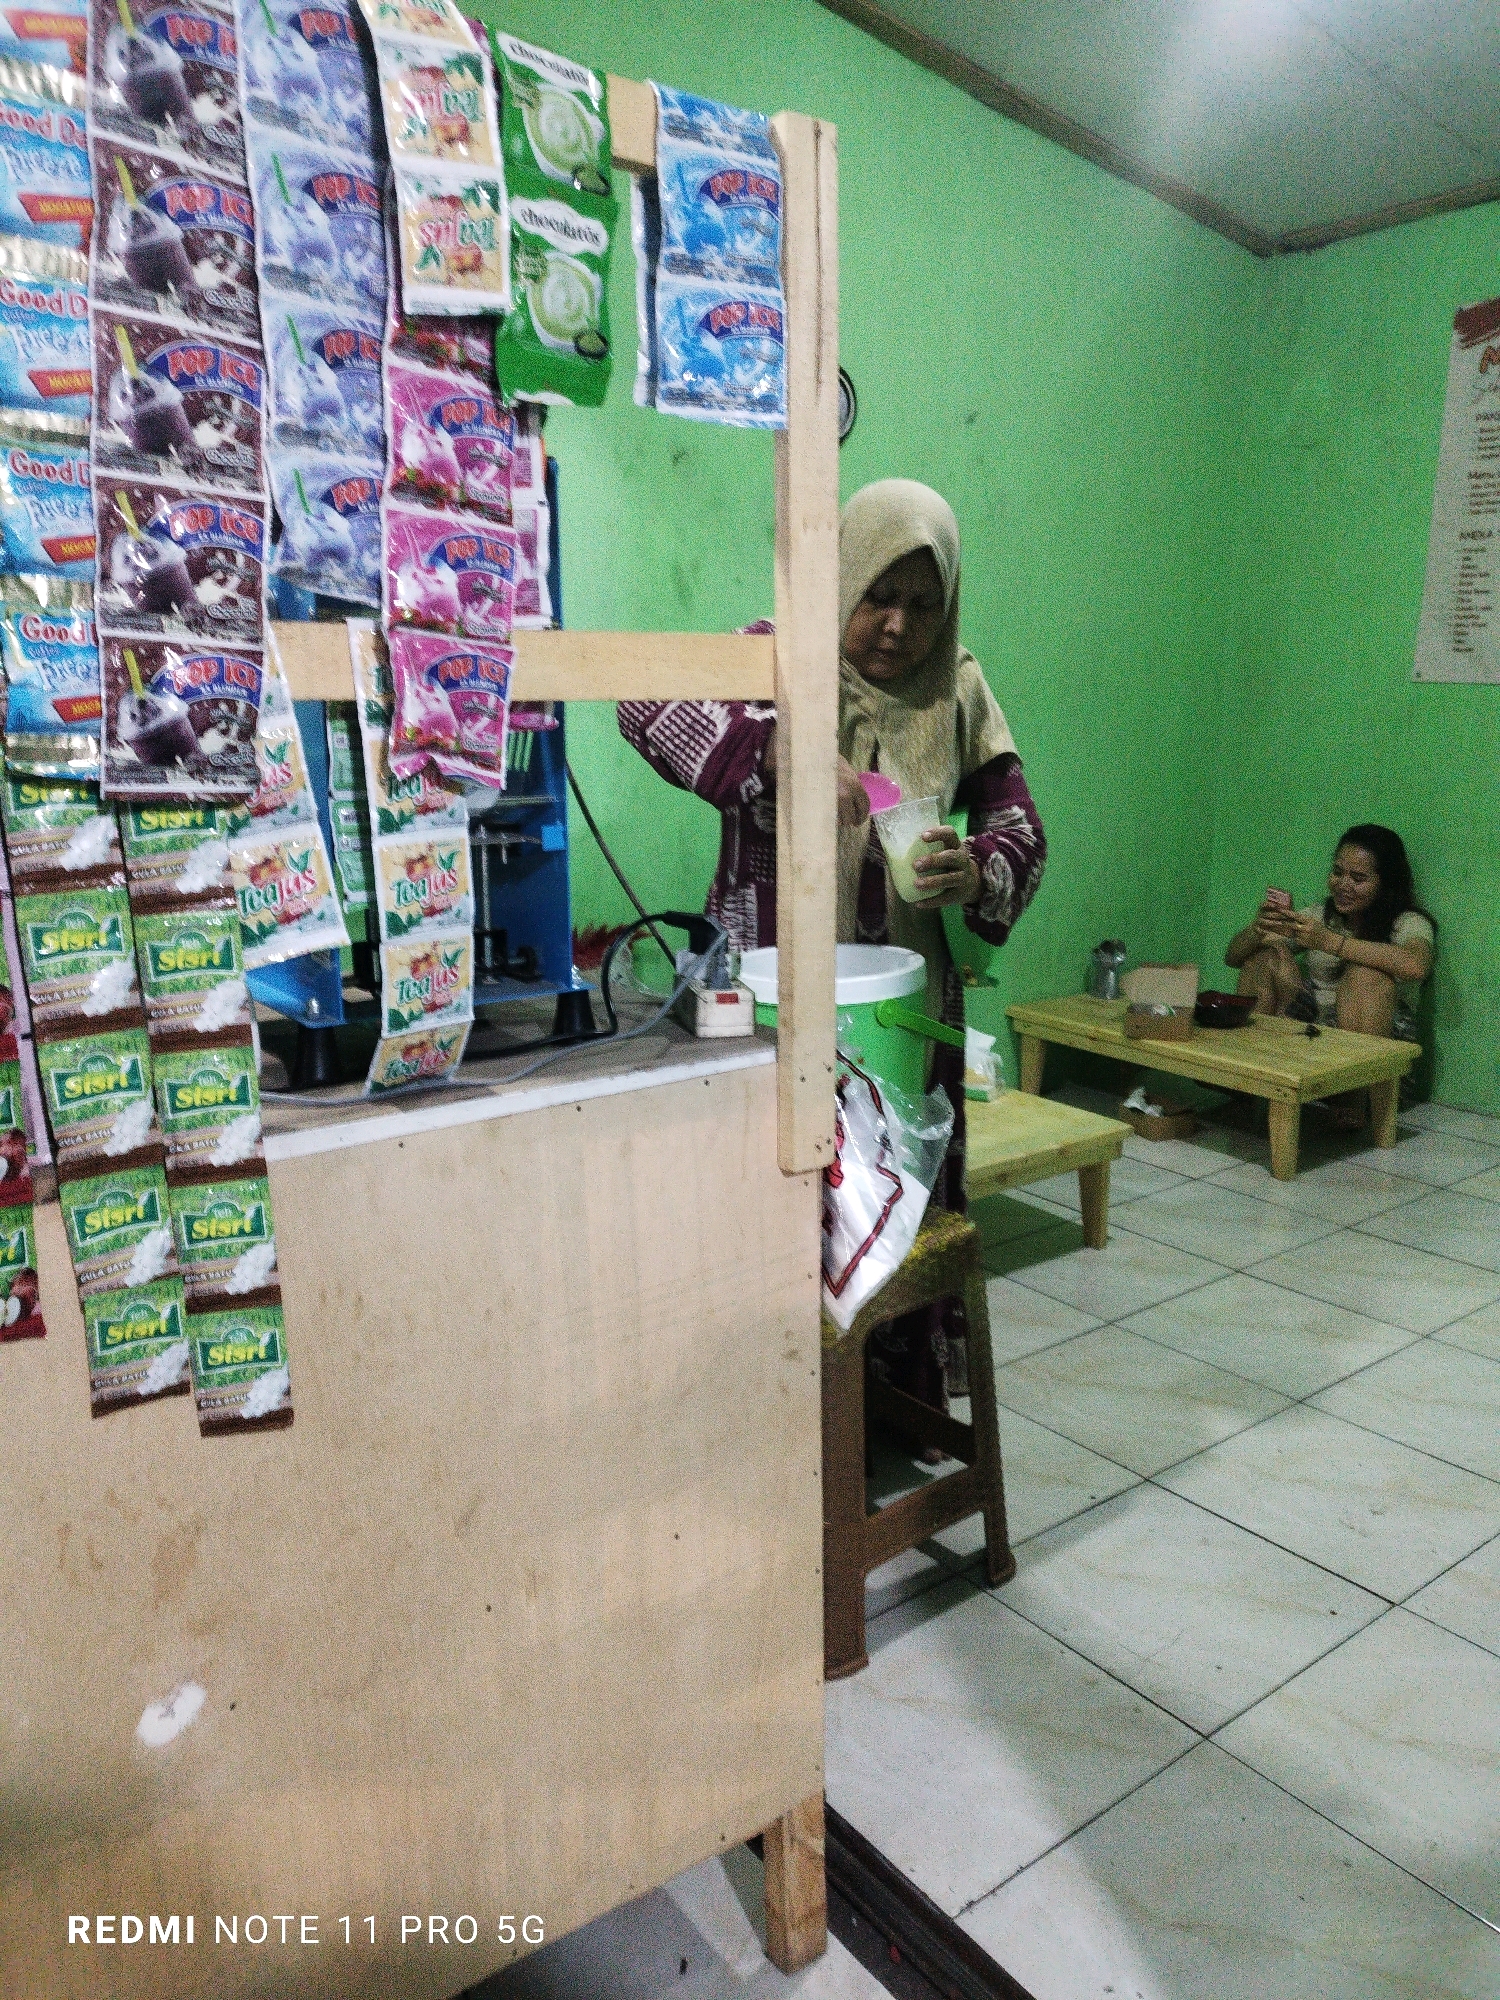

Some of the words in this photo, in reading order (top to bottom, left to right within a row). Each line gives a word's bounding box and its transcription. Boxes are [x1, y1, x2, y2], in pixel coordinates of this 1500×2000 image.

[0, 106, 53, 138] ood
[59, 113, 88, 147] Da
[221, 190, 252, 225] IC
[1, 276, 64, 317] Good
[167, 350, 215, 381] POP
[220, 350, 259, 390] ICE
[9, 451, 74, 484] Good
[168, 507, 215, 541] POP
[220, 508, 260, 544] ICE
[445, 536, 479, 565] POP
[20, 615, 86, 646] Good
[172, 659, 218, 692] POP
[224, 659, 259, 692] ICE
[438, 654, 473, 684] POP
[478, 656, 506, 686] ICE
